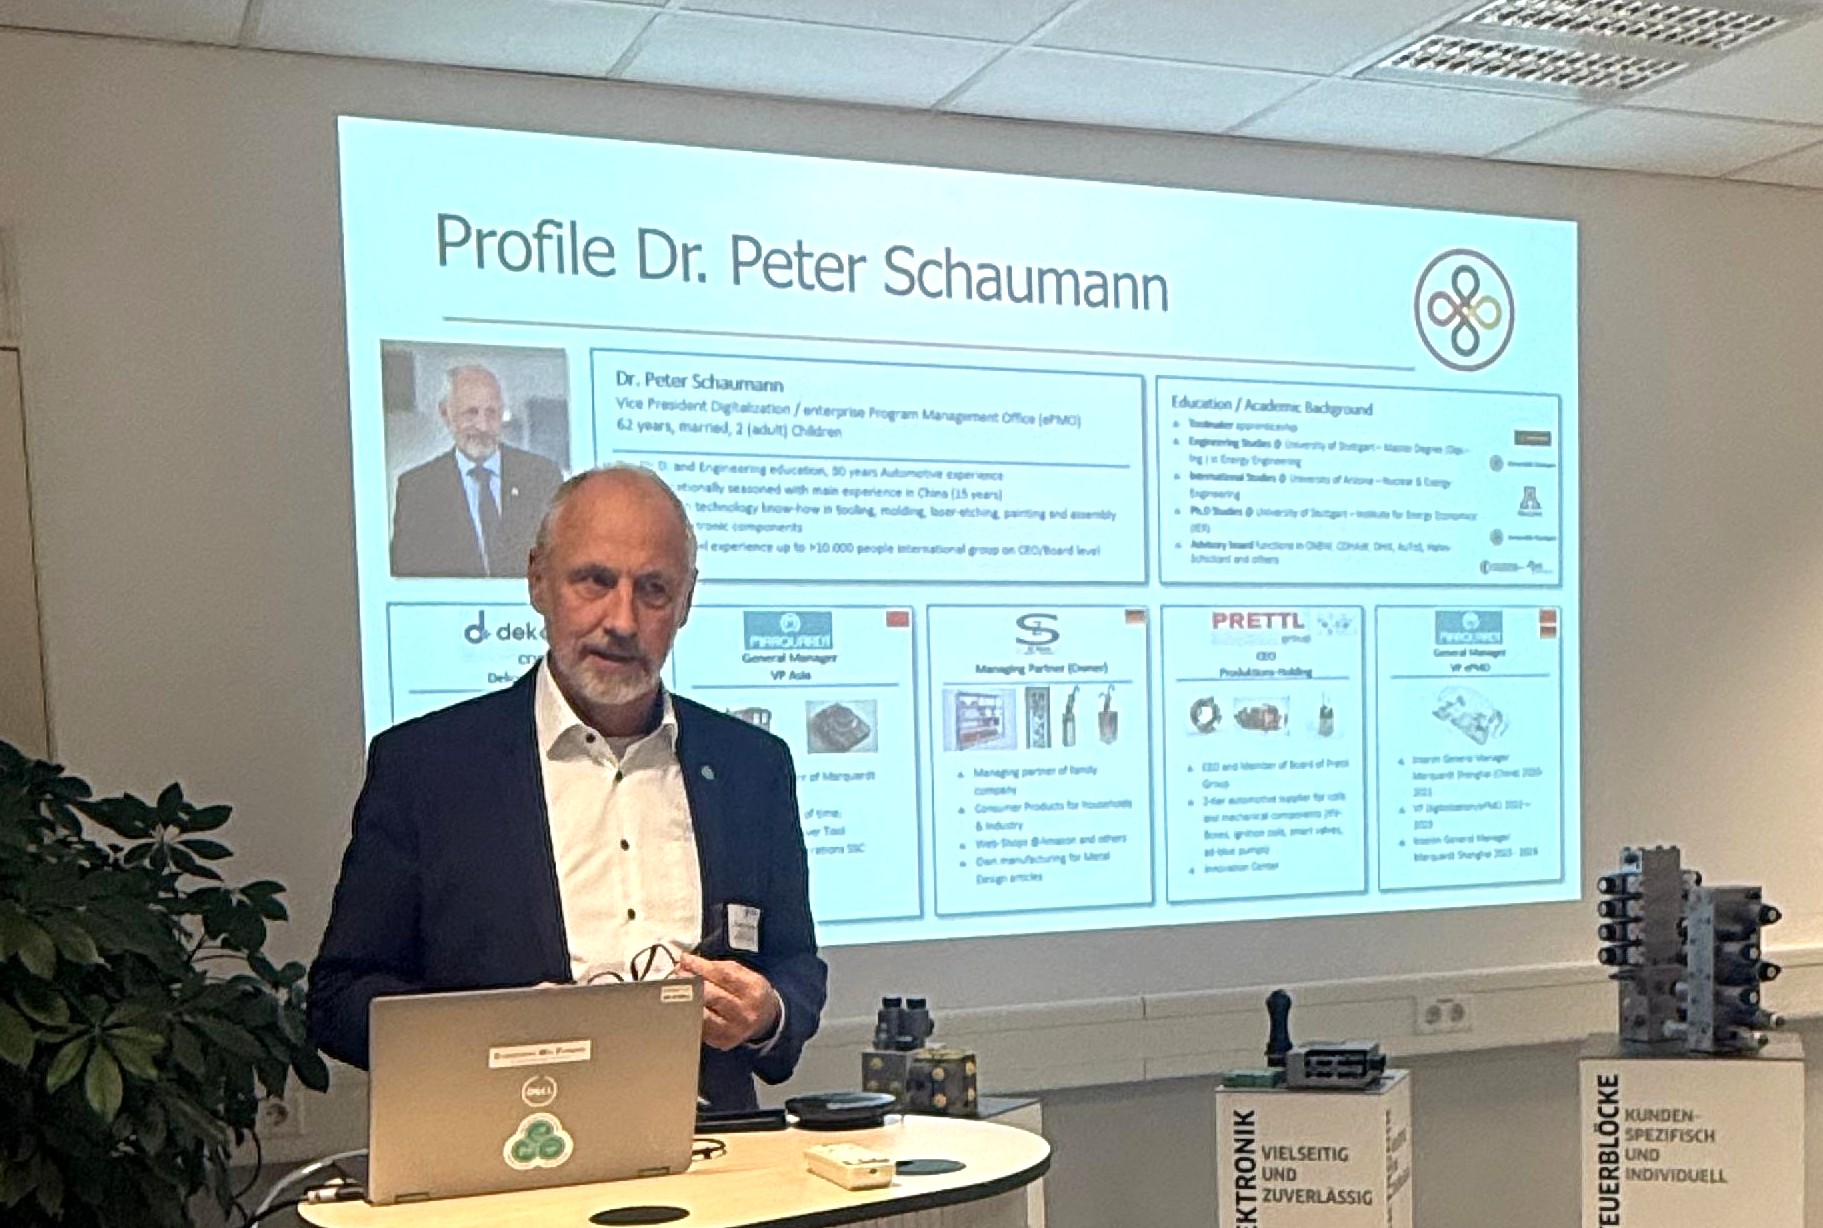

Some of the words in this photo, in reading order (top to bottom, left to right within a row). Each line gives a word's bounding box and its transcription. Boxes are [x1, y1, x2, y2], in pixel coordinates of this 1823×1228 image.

[438, 213, 616, 277] Profile
[637, 226, 706, 283] Dr.
[732, 233, 867, 291] Peter
[884, 245, 1168, 311] Schaumann
[616, 370, 640, 387] Dr.
[645, 371, 688, 389] Peter
[692, 373, 784, 393] Schaumann
[617, 397, 643, 410] Vice
[648, 398, 707, 412] President
[803, 405, 866, 419] enterprise
[869, 406, 918, 423] Program
[922, 409, 999, 426] Management
[1002, 411, 1036, 424] Office
[1172, 394, 1232, 410] Education
[1244, 398, 1302, 414] Academic
[1305, 400, 1374, 418] Background
[617, 418, 633, 431] 62
[679, 422, 731, 437] married,
[792, 425, 842, 438] Children
[770, 465, 828, 478] education,
[881, 468, 943, 480] Automotive
[946, 470, 1003, 481] experience
[785, 485, 808, 496] with
[917, 488, 948, 500] China
[695, 502, 758, 515] technology
[711, 541, 773, 554] experience
[1211, 611, 1305, 630] PRETTL
[742, 652, 787, 664] General
[770, 669, 786, 681] VP
[788, 670, 812, 681] Asia
[975, 663, 1025, 675] Managing
[1028, 662, 1065, 673] Partner
[1625, 1108, 1700, 1123] KUNDEN-
[1625, 1128, 1716, 1143] SPEZIFISCH
[1262, 1145, 1349, 1163] VIELSEITIG
[1625, 1148, 1661, 1162] UND
[1262, 1166, 1297, 1182] UND
[1625, 1168, 1728, 1184] INDIVIDUELL
[1262, 1186, 1373, 1206] ZUVERLÄSSIG
